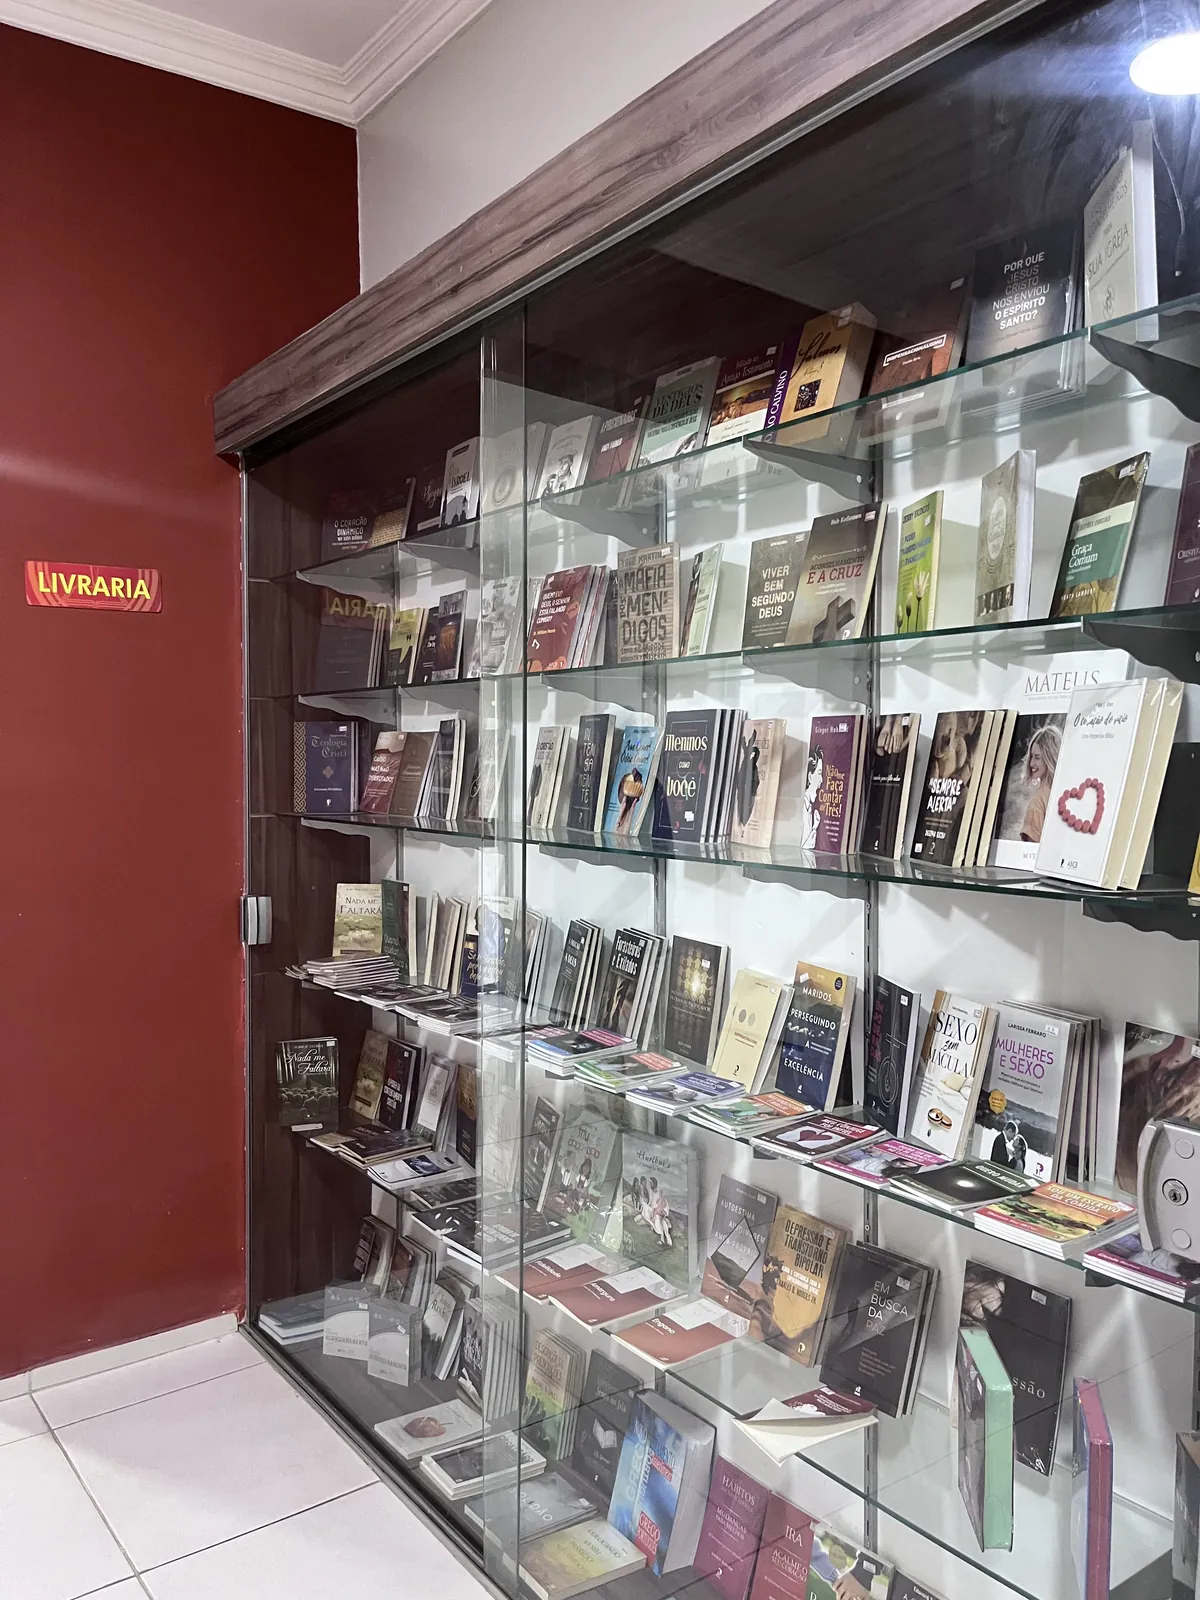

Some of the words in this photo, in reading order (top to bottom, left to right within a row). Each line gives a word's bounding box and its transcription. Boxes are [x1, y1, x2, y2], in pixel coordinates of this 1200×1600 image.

[1003, 258, 1024, 275] POR
[1024, 251, 1045, 268] QUE
[1006, 264, 1040, 285] JESUS
[1005, 275, 1040, 296] CRISTO
[992, 295, 1014, 312] NOS
[1013, 283, 1051, 302] ENVIOU
[994, 310, 1002, 321] O
[1002, 296, 1046, 318] ESPÍRITO
[999, 309, 1039, 331] SANTO?
[769, 369, 789, 416] CALVINO
[1068, 552, 1099, 569] Comum
[1071, 543, 1093, 558] Graça
[623, 563, 667, 594] MÁFIA
[761, 565, 790, 580] VIVER
[806, 571, 817, 585] E
[816, 573, 826, 584] A
[829, 563, 864, 582] CRUZ
[38, 571, 151, 600] LIVRARIA
[763, 579, 784, 592] BEM
[751, 590, 795, 608] SEGUNDO
[758, 605, 783, 619] DEUS
[621, 614, 668, 646] DIGOS
[311, 735, 348, 749] Teologia
[664, 733, 709, 752] Meninos
[321, 747, 348, 759] Cristã
[678, 760, 691, 769] COMO
[825, 764, 839, 778] Não
[818, 788, 843, 804] Contar
[825, 776, 844, 796] Faça
[825, 802, 842, 818] Três!
[339, 902, 383, 915] FALTARÁ
[345, 896, 367, 905] NADA
[802, 986, 833, 1003] MARIDOS
[790, 1007, 836, 1031] PERSEGUINDO
[933, 1009, 978, 1046] SEXO
[1007, 1022, 1025, 1033] LARISSA
[1025, 1026, 1047, 1038] FERRARO
[804, 1039, 811, 1049] A
[995, 1037, 1054, 1066] MULHERES
[287, 1049, 317, 1064] Nada
[314, 1054, 326, 1062] me
[297, 1062, 333, 1076] Faltará
[783, 1057, 825, 1083] EXCELÊNCIA
[999, 1054, 1006, 1068] E
[1008, 1056, 1045, 1081] SEXO
[1047, 1184, 1067, 1198] SOU
[1066, 1191, 1081, 1203] UM
[1079, 1196, 1122, 1214] ESCRAVO
[1050, 1192, 1064, 1204] DA
[1063, 1196, 1102, 1214] COMIDA
[720, 1199, 756, 1222] AUTOESTIMA
[784, 1219, 825, 1245] DEPRESSÃO
[825, 1237, 832, 1247] E
[783, 1234, 829, 1265] TRANSTORNO
[794, 1255, 825, 1279] BIPOLAR
[873, 1279, 890, 1295] EM
[867, 1306, 883, 1321] DA
[870, 1294, 909, 1317] BUSCA
[651, 1317, 676, 1335] Engano
[864, 1318, 887, 1338] PAZ
[722, 1474, 756, 1507] HÁBITOS
[509, 1486, 553, 1522] SOLIDÃO
[639, 1512, 661, 1542] GREGO
[784, 1524, 804, 1548] IRA
[772, 1549, 802, 1571] ACALME
